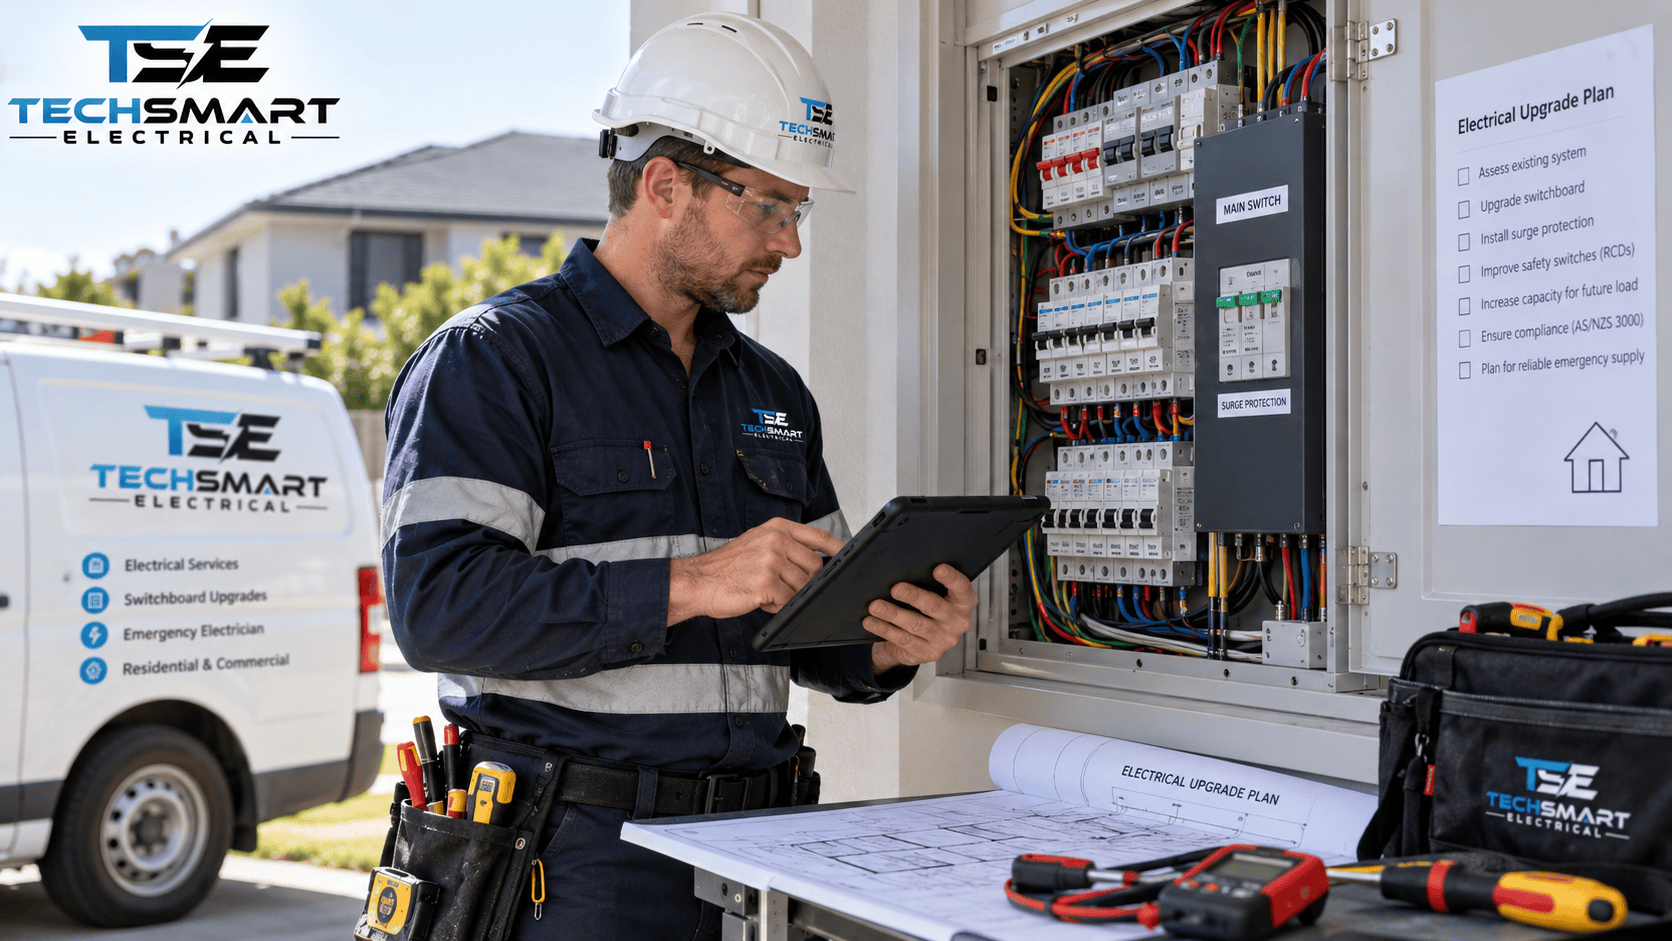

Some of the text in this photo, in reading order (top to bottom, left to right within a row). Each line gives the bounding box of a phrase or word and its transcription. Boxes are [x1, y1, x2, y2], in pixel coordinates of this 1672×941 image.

[1457, 85, 1615, 135] Electrical Upgrade Plan
[1478, 145, 1587, 179] Assess existing system
[1223, 194, 1281, 216] MAIN SWITCH
[1480, 180, 1585, 214] Upgrade switchboard
[1480, 215, 1595, 245] Install surge protection
[1480, 242, 1636, 279] Improve safety switches (RCDs)
[1481, 277, 1639, 310] Increase capacity for future load
[1481, 312, 1645, 343] Ensure compliance (AS/NZS 3000)
[1481, 348, 1645, 375] Plan for reliable emergency supply
[751, 408, 789, 427] TSE
[1221, 397, 1287, 411] SURGE PROTECTION
[143, 405, 282, 463] TSE
[741, 423, 803, 439] TECHSMART
[89, 464, 328, 498] TECHSMART
[134, 494, 290, 513] ELECTRICAL
[125, 558, 239, 572] Electrical Services
[124, 590, 267, 606] Switchboard Upgrades
[123, 623, 265, 642] Emergency Electrician
[123, 653, 290, 676] Residential & Commercial
[1121, 765, 1280, 806] ELECTRICAL UPGRADE PLAN
[1515, 756, 1600, 800] TSE
[1486, 791, 1632, 830] TECHSMART
[1506, 812, 1602, 838] ELECTRICAL
